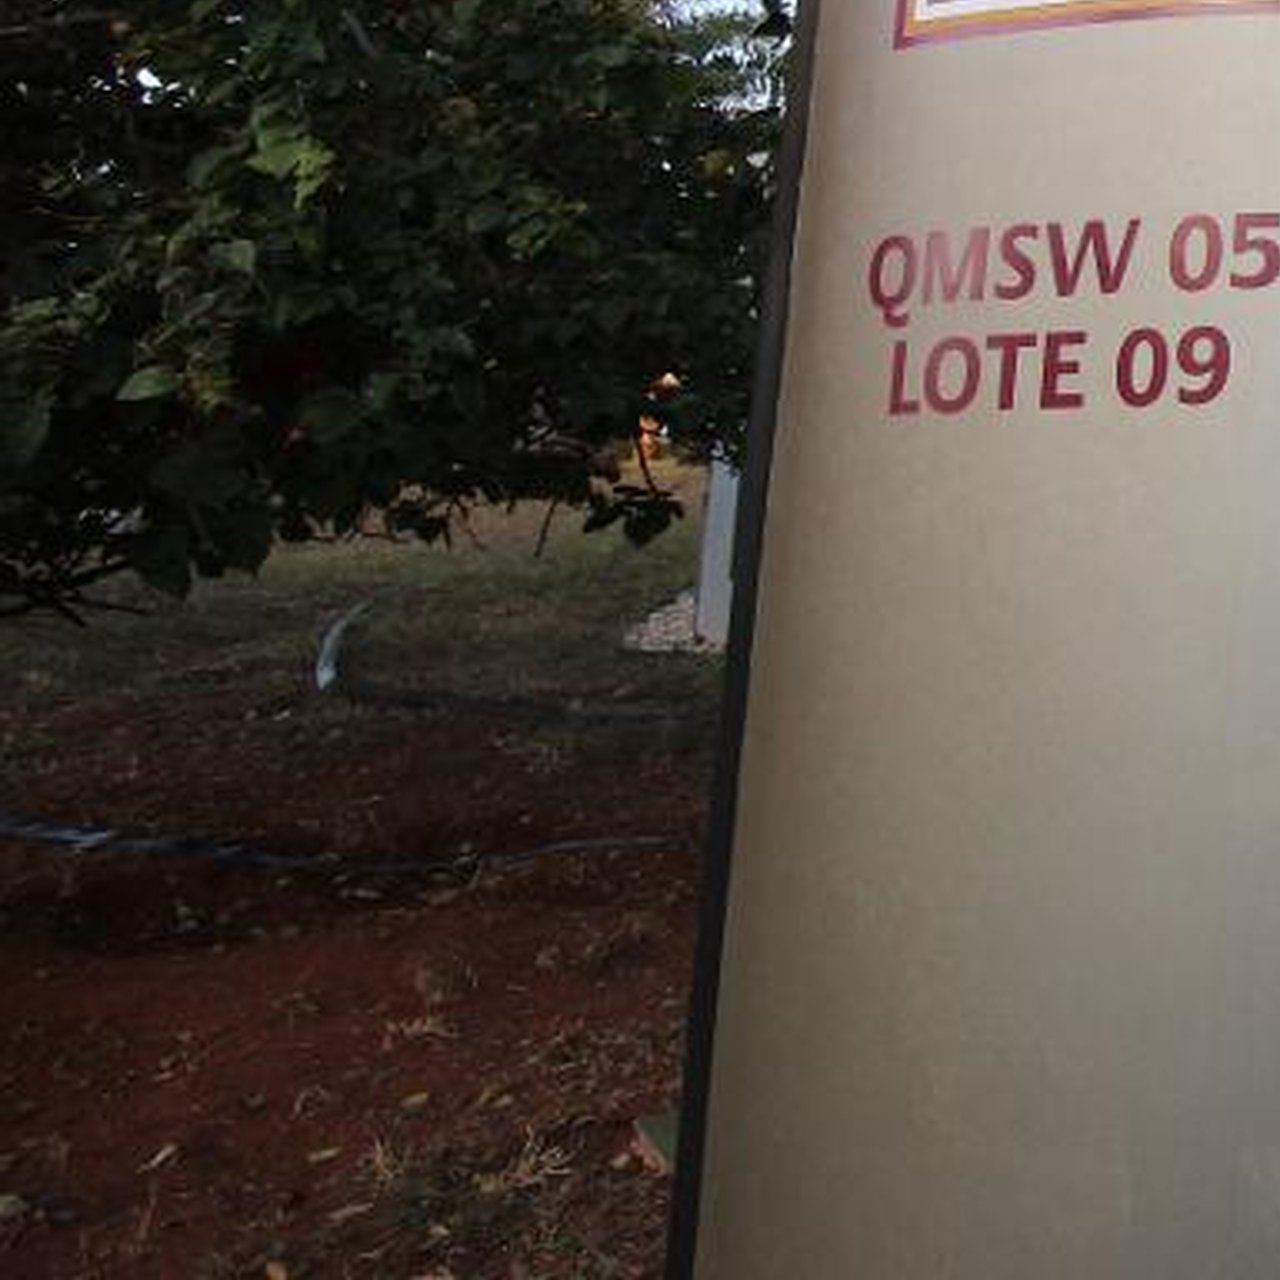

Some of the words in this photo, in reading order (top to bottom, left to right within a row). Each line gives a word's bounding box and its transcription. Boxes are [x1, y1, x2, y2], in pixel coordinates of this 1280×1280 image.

[868, 217, 1142, 328] QMSW
[889, 330, 1088, 417] LOTE
[1115, 325, 1232, 408] 09
